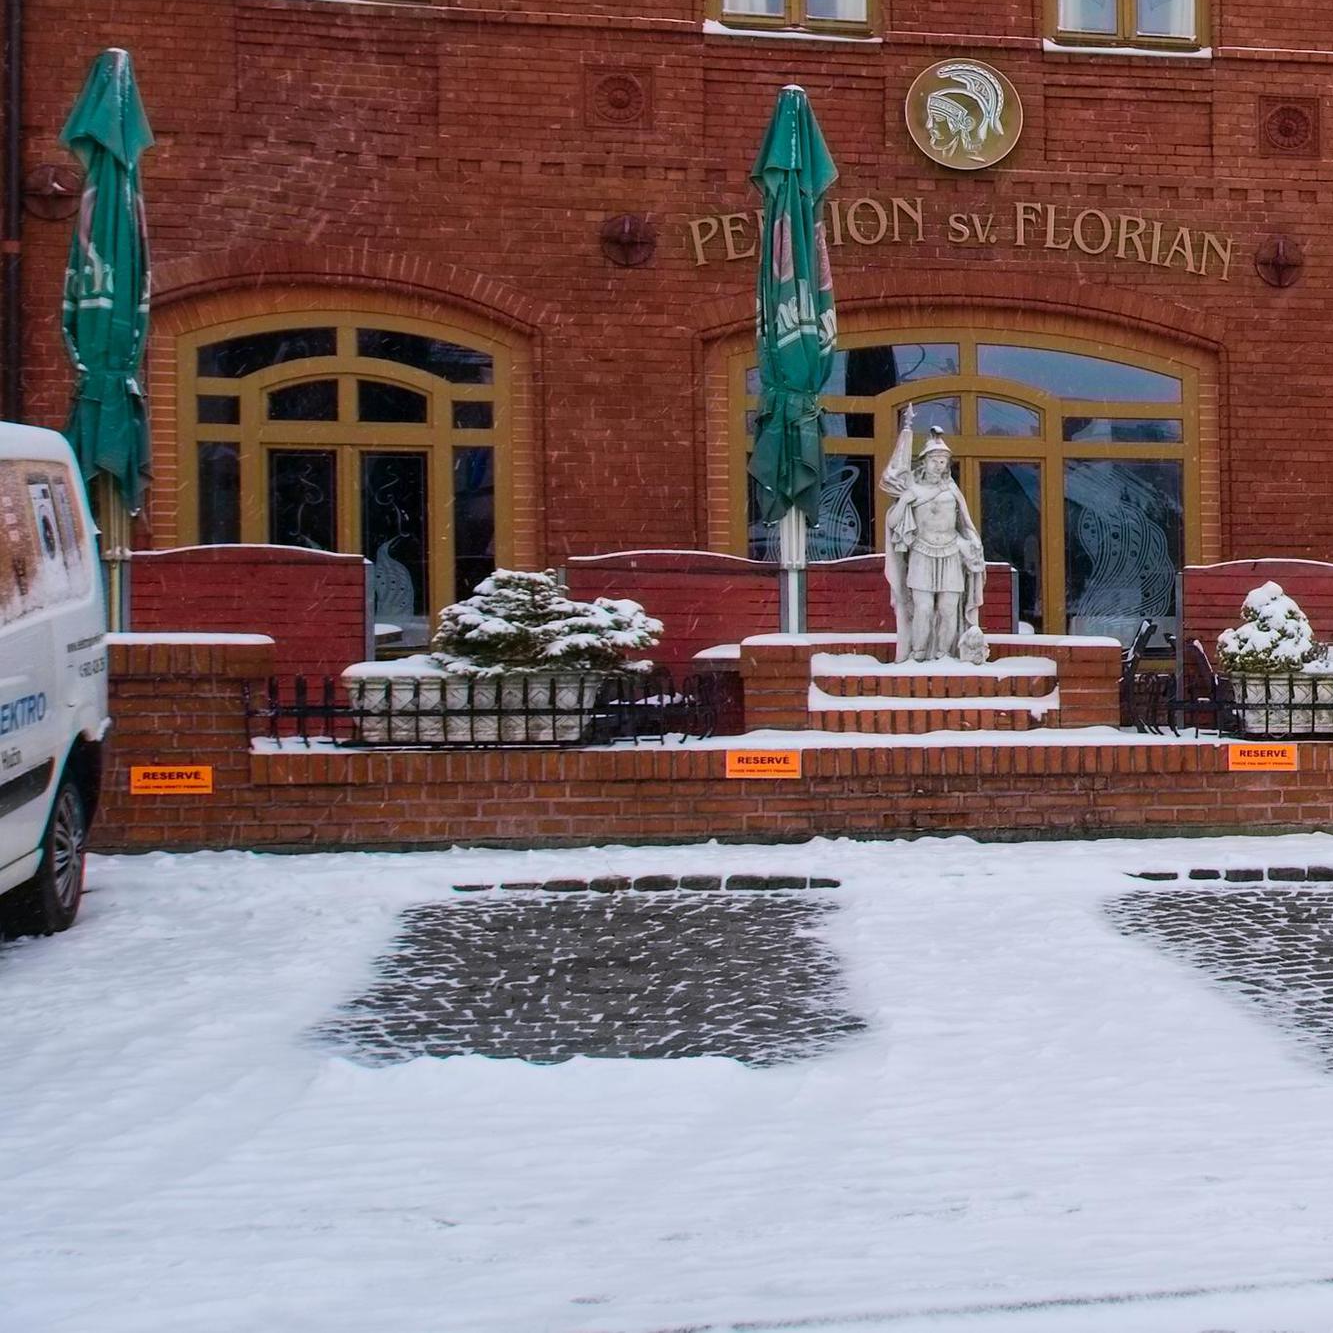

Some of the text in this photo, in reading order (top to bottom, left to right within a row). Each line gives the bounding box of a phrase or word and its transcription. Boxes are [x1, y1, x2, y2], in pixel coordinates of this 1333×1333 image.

[688, 197, 925, 266] PEION
[1015, 201, 1234, 282] FLORIAN
[1239, 748, 1288, 758] RESERVÉ
[737, 755, 790, 765] RESERVÉ
[142, 770, 201, 780] RESERVÉ
